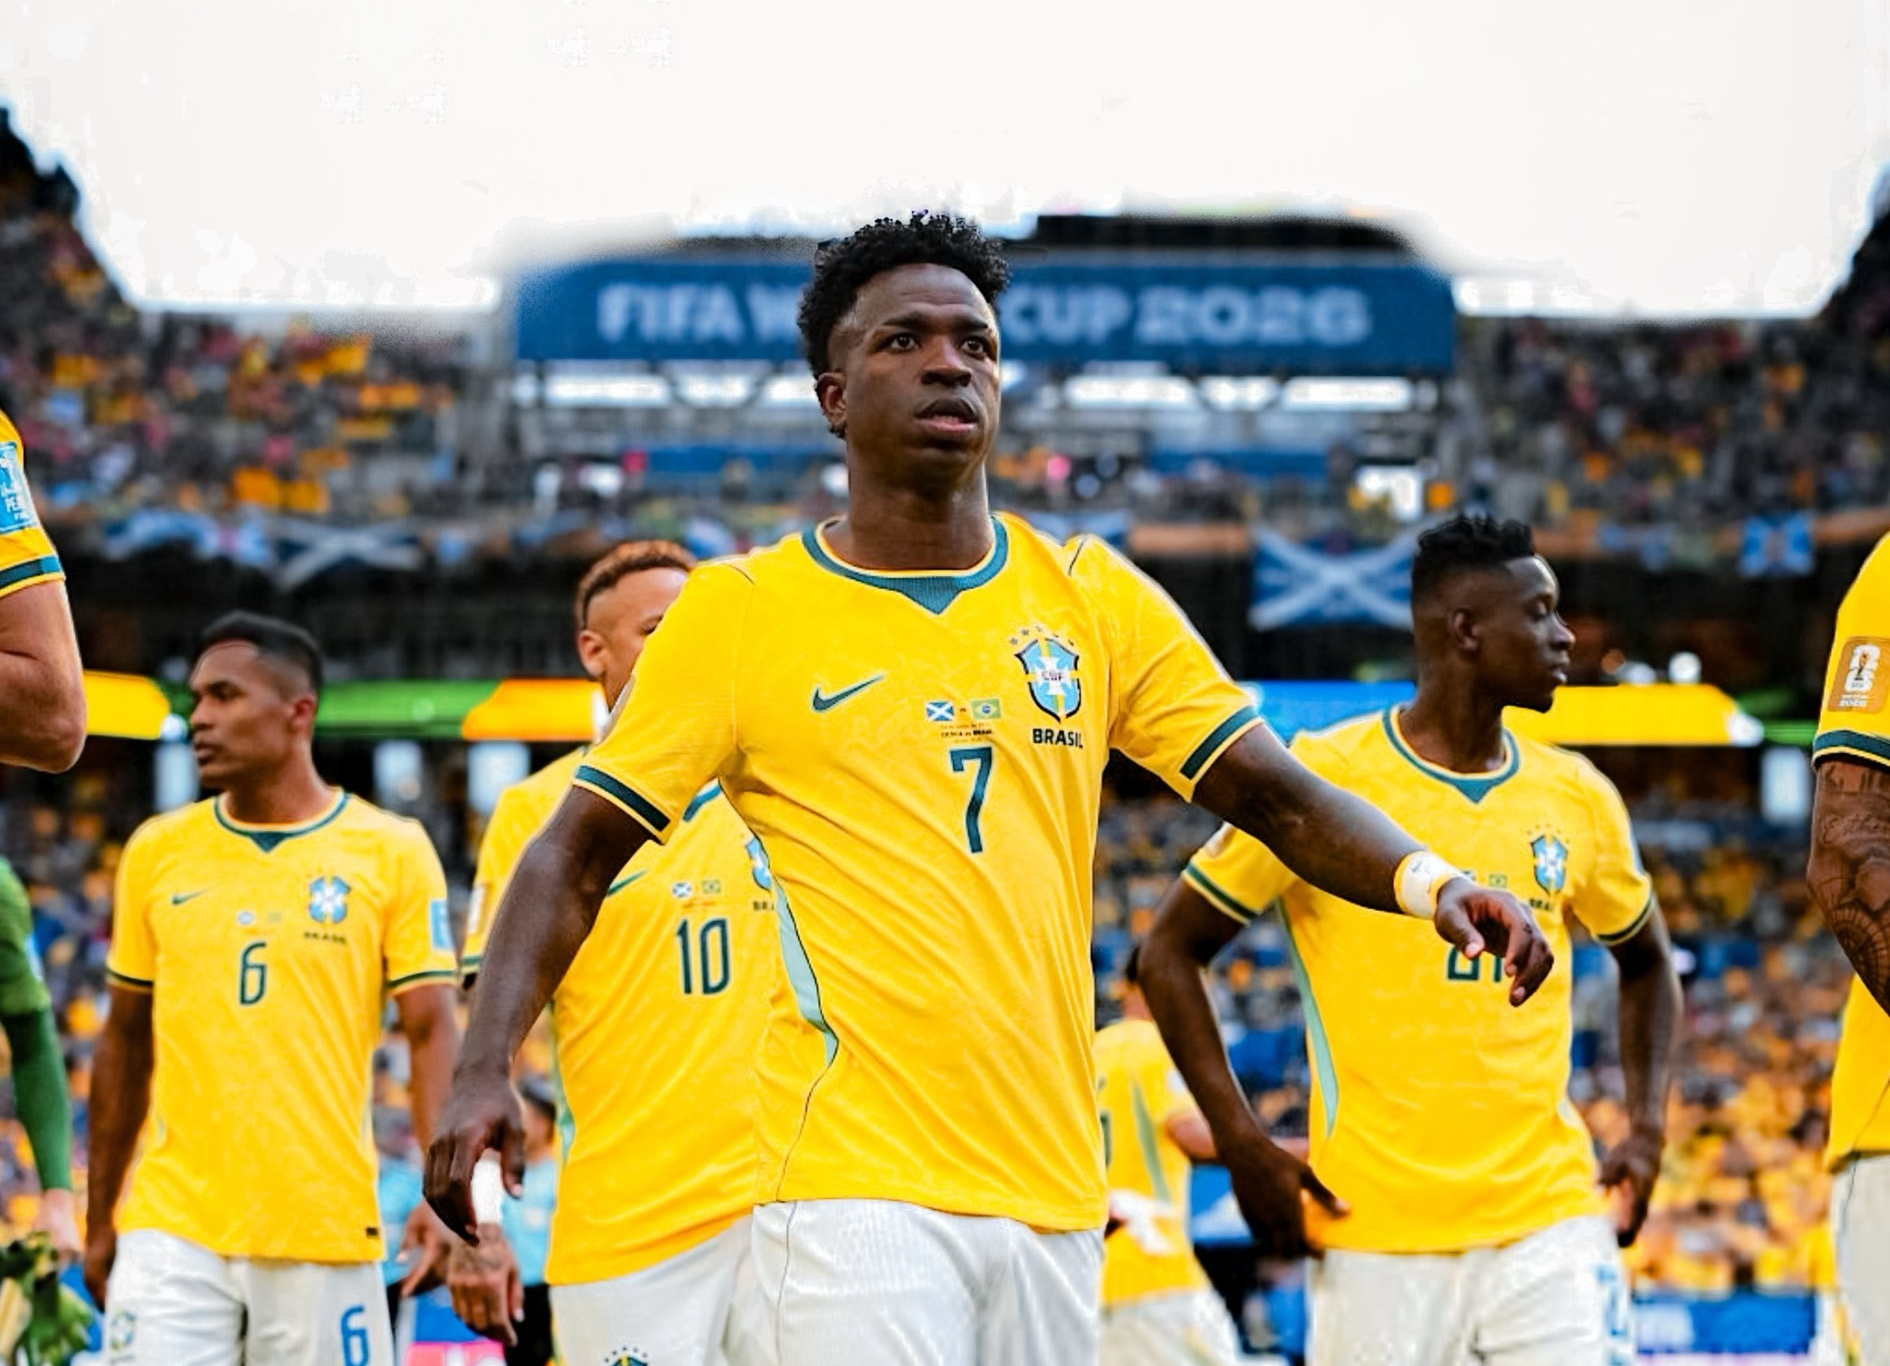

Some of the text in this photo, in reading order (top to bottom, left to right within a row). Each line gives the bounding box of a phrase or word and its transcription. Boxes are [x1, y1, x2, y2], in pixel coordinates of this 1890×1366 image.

[598, 283, 744, 343] FIFA
[998, 284, 1132, 344] CUP
[1134, 285, 1371, 345] 2026
[1033, 728, 1083, 749] BRASIL
[949, 747, 992, 853] 7
[239, 941, 267, 1006] 6
[676, 918, 730, 995] 10
